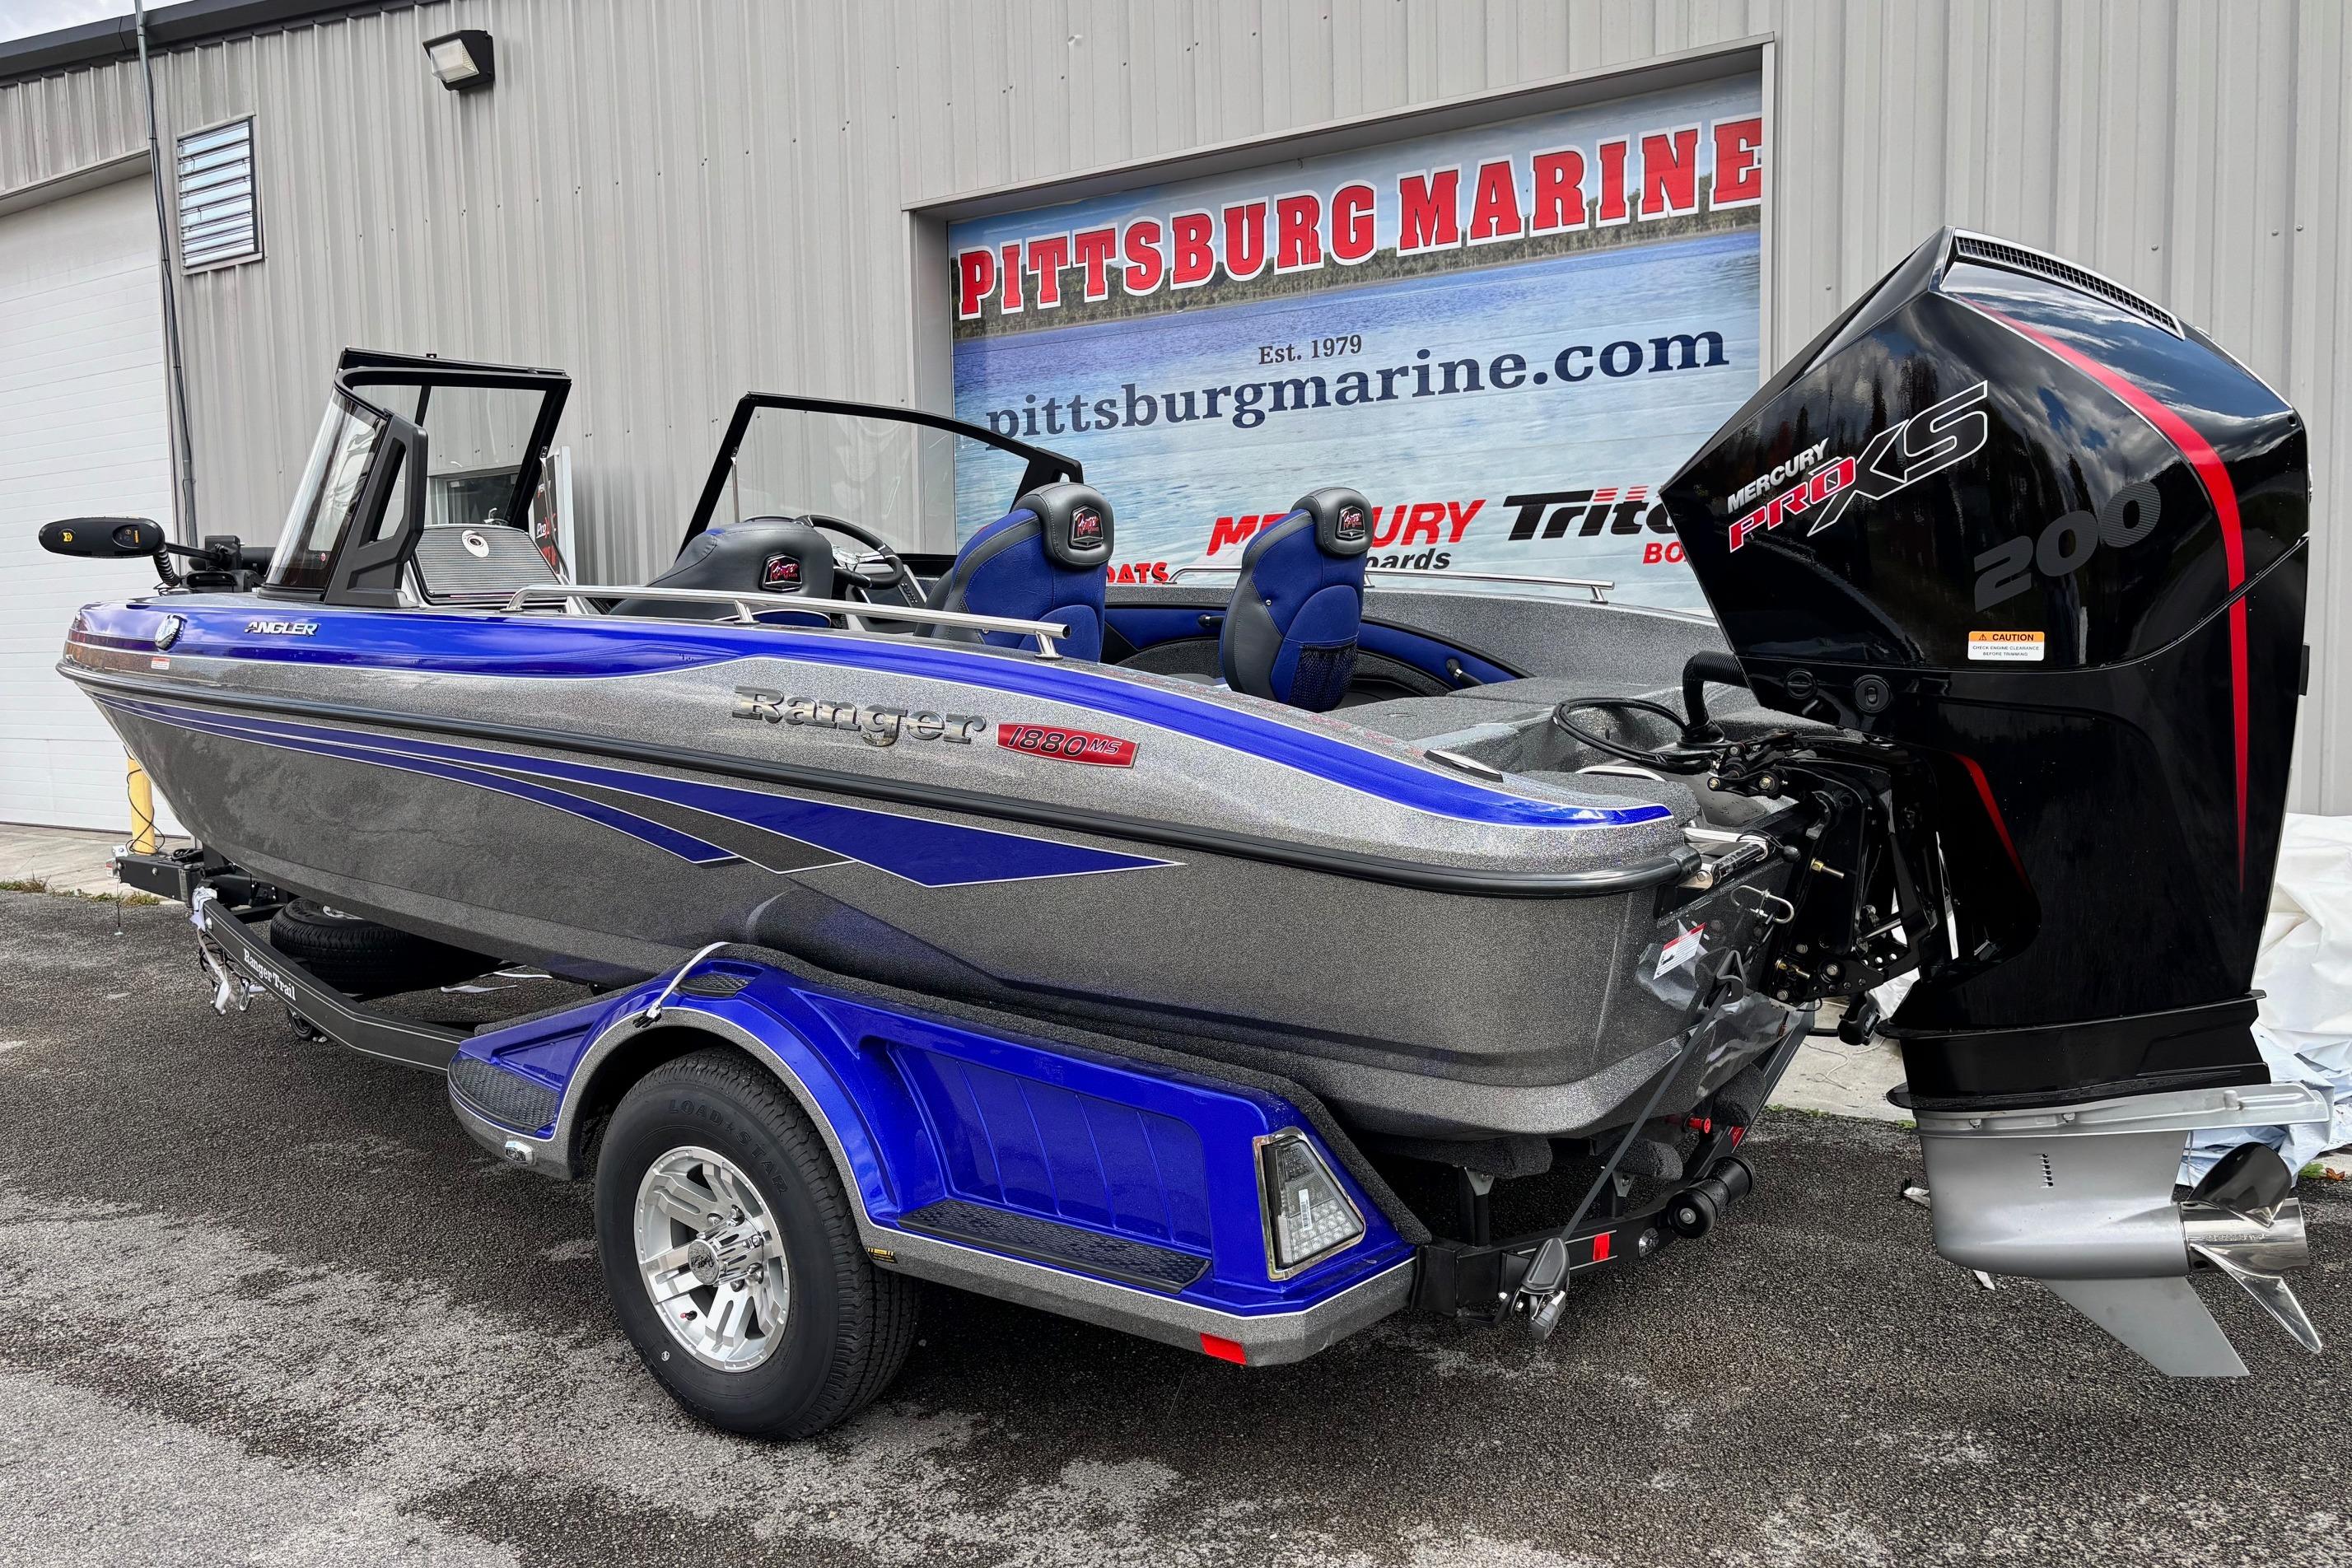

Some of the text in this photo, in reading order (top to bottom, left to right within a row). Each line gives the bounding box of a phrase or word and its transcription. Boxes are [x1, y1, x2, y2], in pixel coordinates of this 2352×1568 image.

[959, 113, 1762, 320] PITTSBURG MARINE
[1258, 334, 1362, 365] Est. 1979
[986, 331, 1729, 450] pittsburgmarine.com
[1728, 437, 1830, 514] MERCURY
[1729, 456, 1856, 553] PRO
[1974, 482, 2162, 613] 200
[245, 621, 320, 637] ANGLER
[1992, 633, 2034, 642] CAUTION
[732, 685, 987, 746] Ranger
[1008, 726, 1122, 756] 1880 MS
[243, 948, 296, 1001] Ranger Trail
[668, 1099, 789, 1194] LOAD STAR
